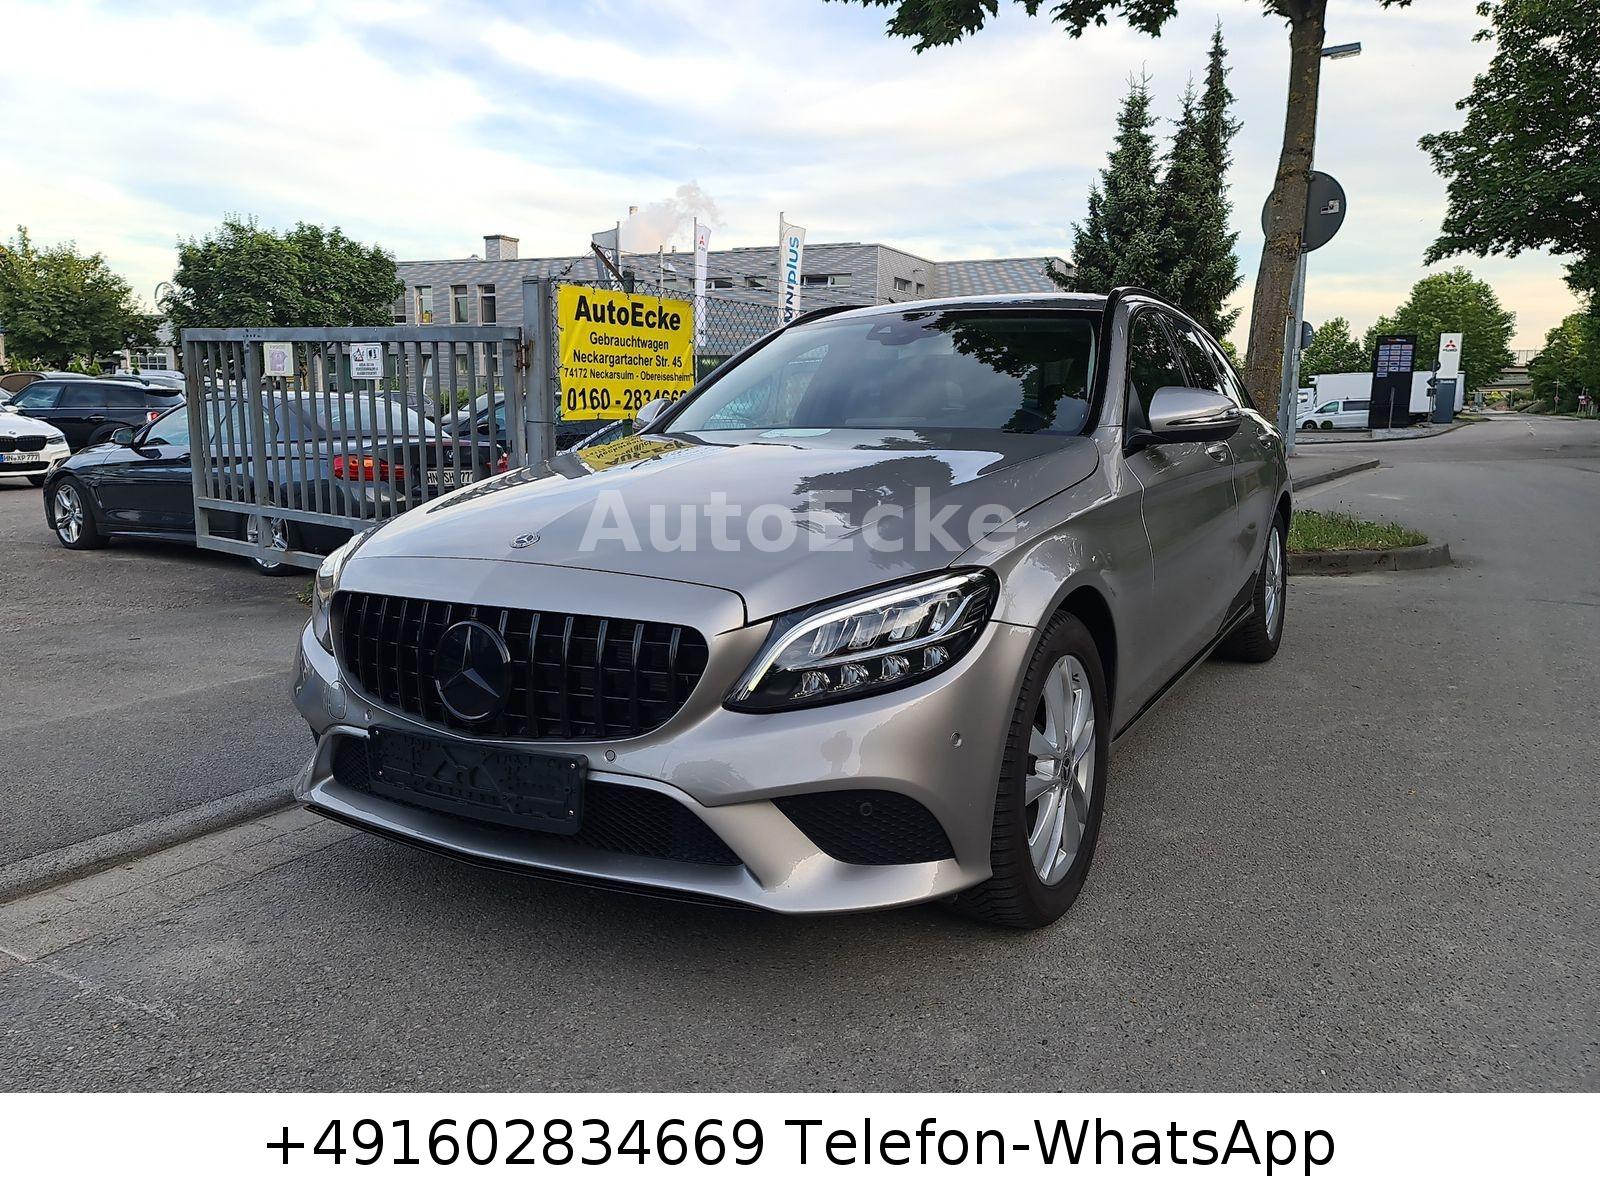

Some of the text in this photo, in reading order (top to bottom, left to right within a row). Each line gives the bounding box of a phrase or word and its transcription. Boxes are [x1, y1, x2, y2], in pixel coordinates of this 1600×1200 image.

[783, 236, 800, 323] MNIplus
[575, 295, 681, 330] AutoEcke
[589, 331, 669, 352] Gebrauchtwagen
[573, 349, 683, 368] Neckargartacher Str. 45
[564, 368, 588, 379] 74172
[590, 368, 634, 380] Neckarsulm
[640, 370, 691, 382] Obereisesheim
[567, 387, 611, 411] 0160
[623, 388, 687, 411] 2836
[460, 471, 473, 483] 77
